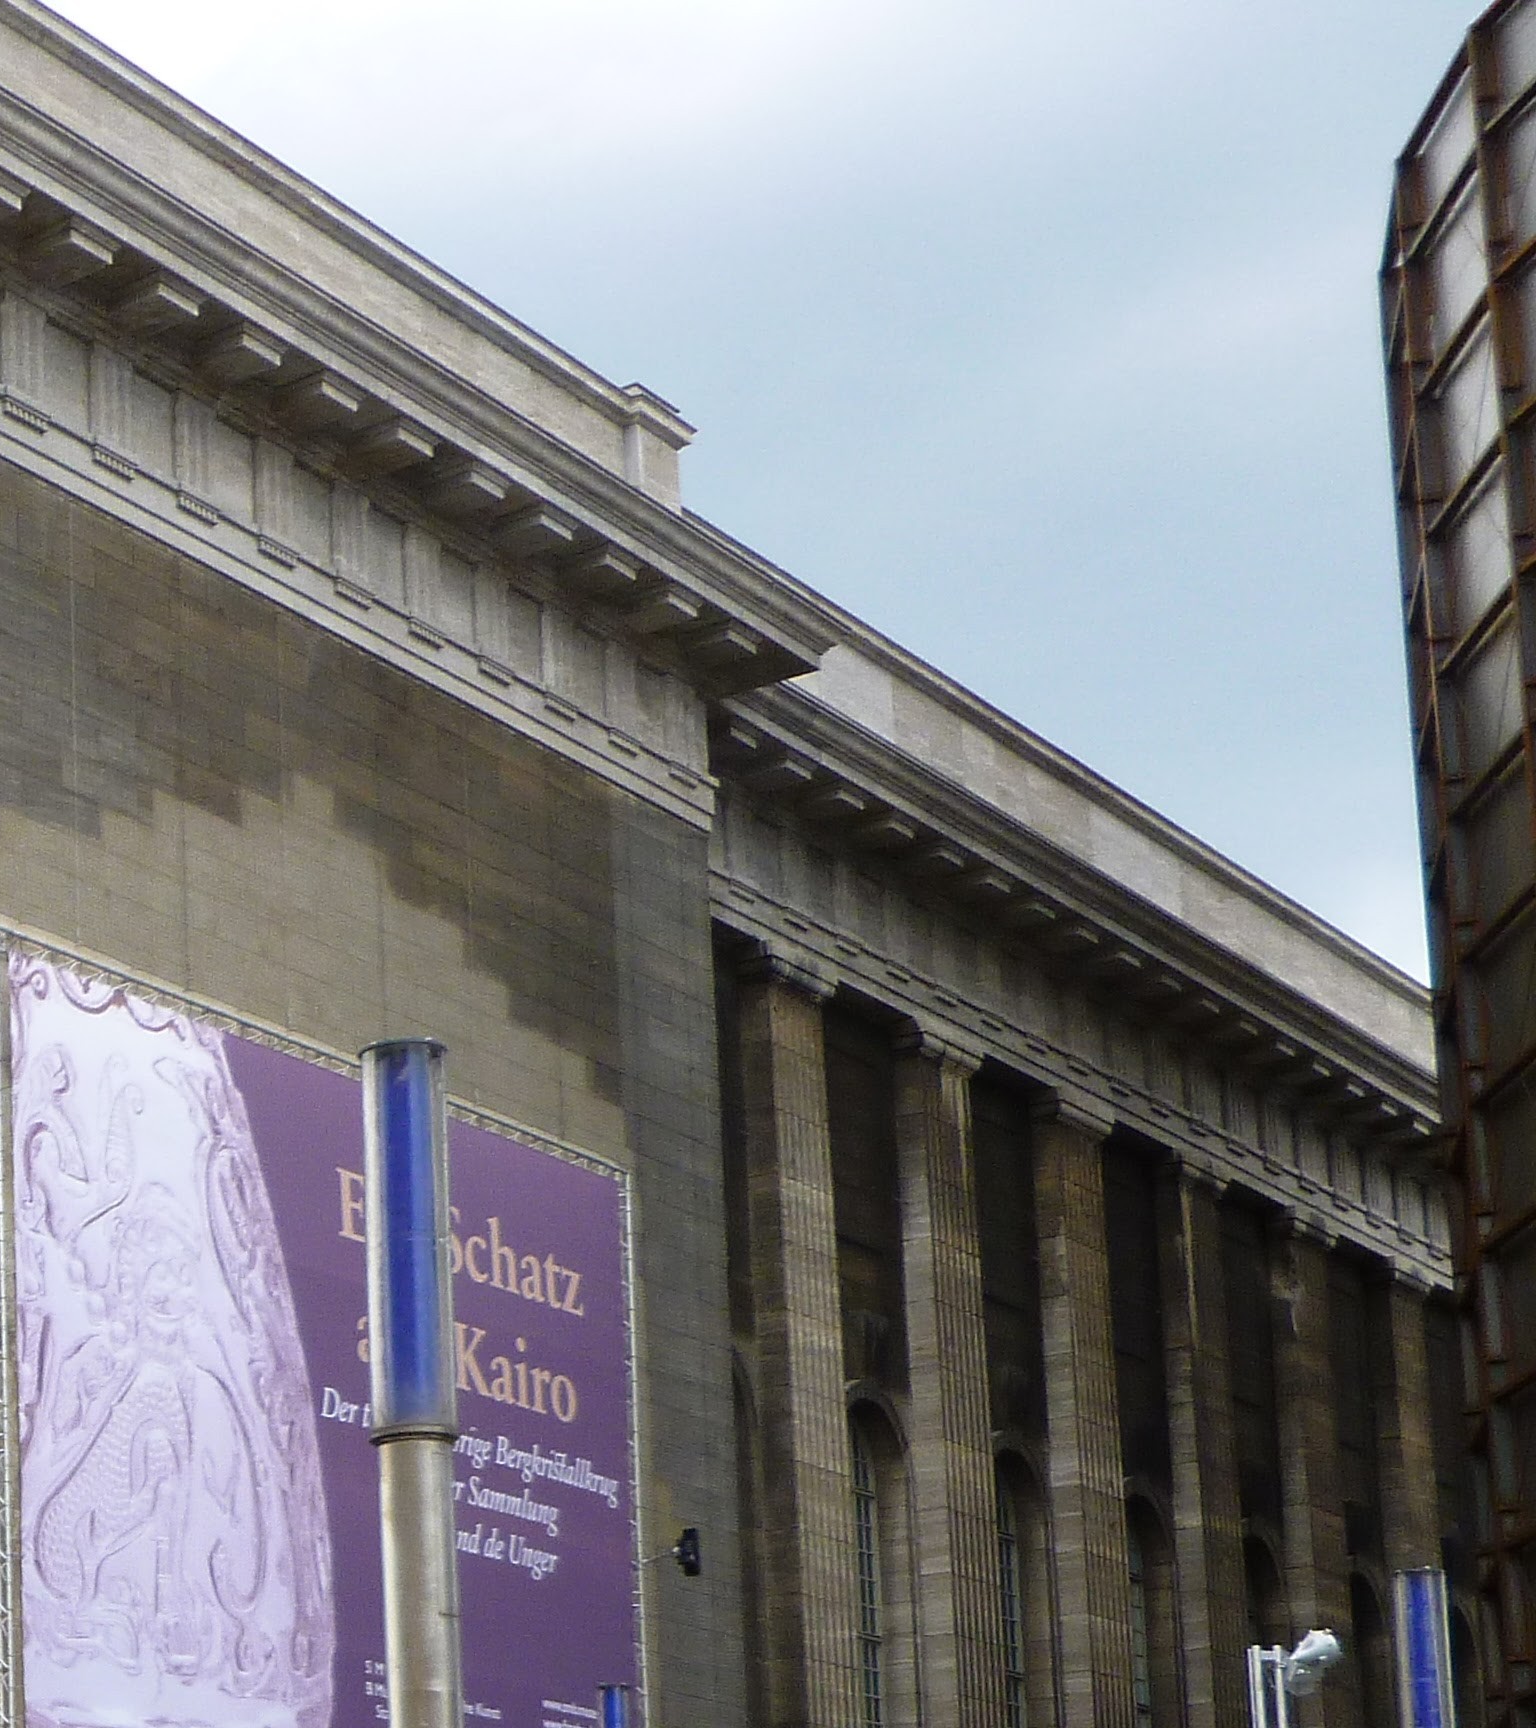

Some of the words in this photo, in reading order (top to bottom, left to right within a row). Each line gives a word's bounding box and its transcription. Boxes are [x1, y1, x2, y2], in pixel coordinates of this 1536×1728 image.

[454, 1321, 577, 1423] Kairo
[321, 1387, 360, 1423] Der
[468, 1476, 559, 1537] Sammlung
[484, 1528, 504, 1560] de
[509, 1534, 559, 1580] Unger
